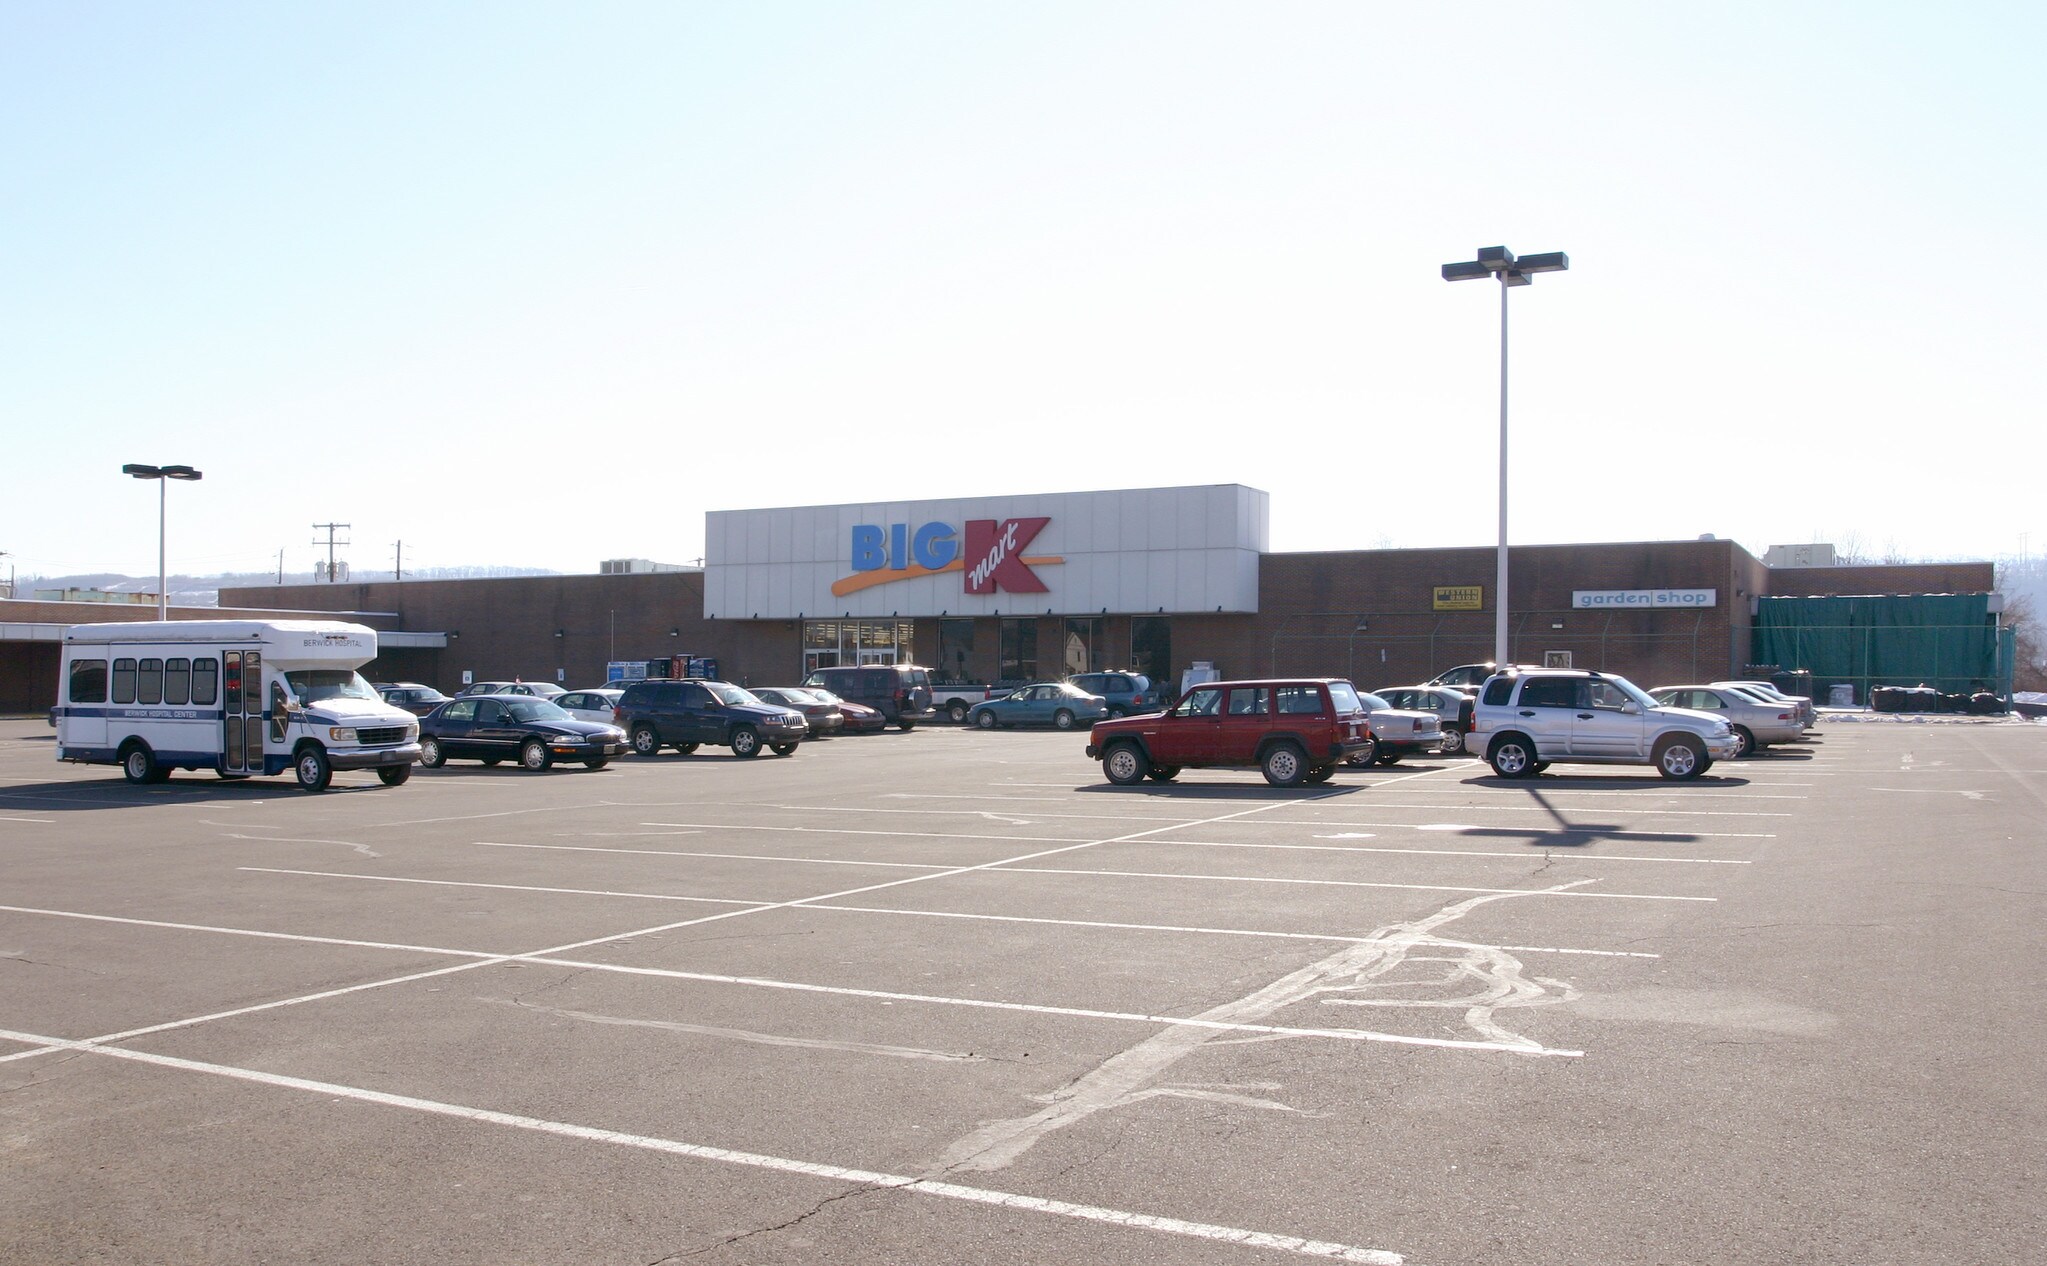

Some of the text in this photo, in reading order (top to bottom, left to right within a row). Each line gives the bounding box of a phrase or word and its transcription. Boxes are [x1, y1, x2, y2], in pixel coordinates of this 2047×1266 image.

[852, 521, 959, 571] BIG
[968, 522, 1019, 590] mart
[1581, 591, 1708, 607] garden shop
[303, 639, 333, 647] BERWICK
[149, 710, 173, 718] HOSPITAL
